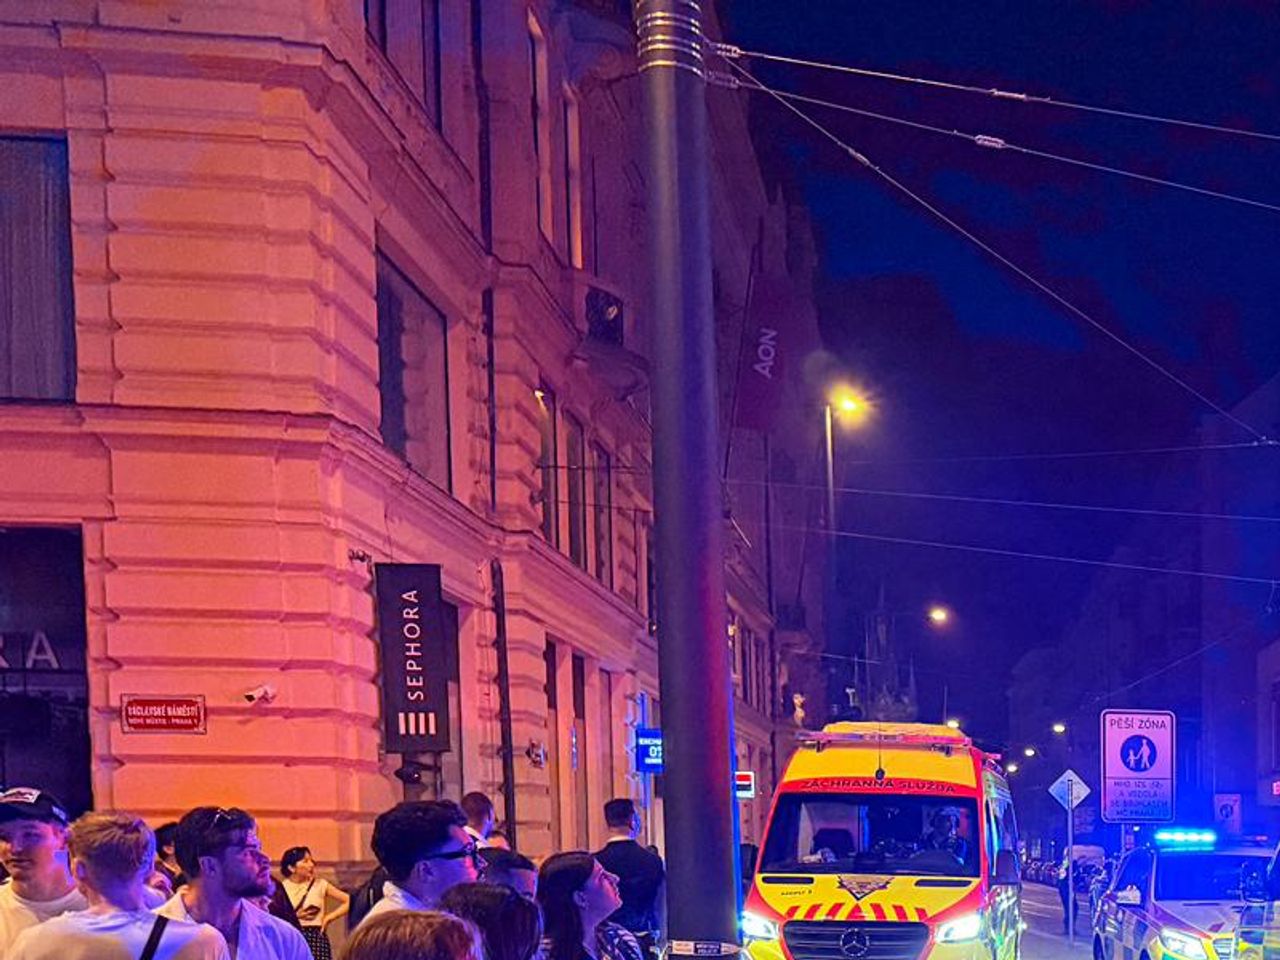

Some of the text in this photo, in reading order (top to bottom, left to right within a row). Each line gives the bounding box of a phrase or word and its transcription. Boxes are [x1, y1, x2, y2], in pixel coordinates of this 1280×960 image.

[753, 327, 778, 379] AON
[401, 590, 424, 701] SEPHORA
[1110, 717, 1166, 729] PĚŠÍ ZÓNA
